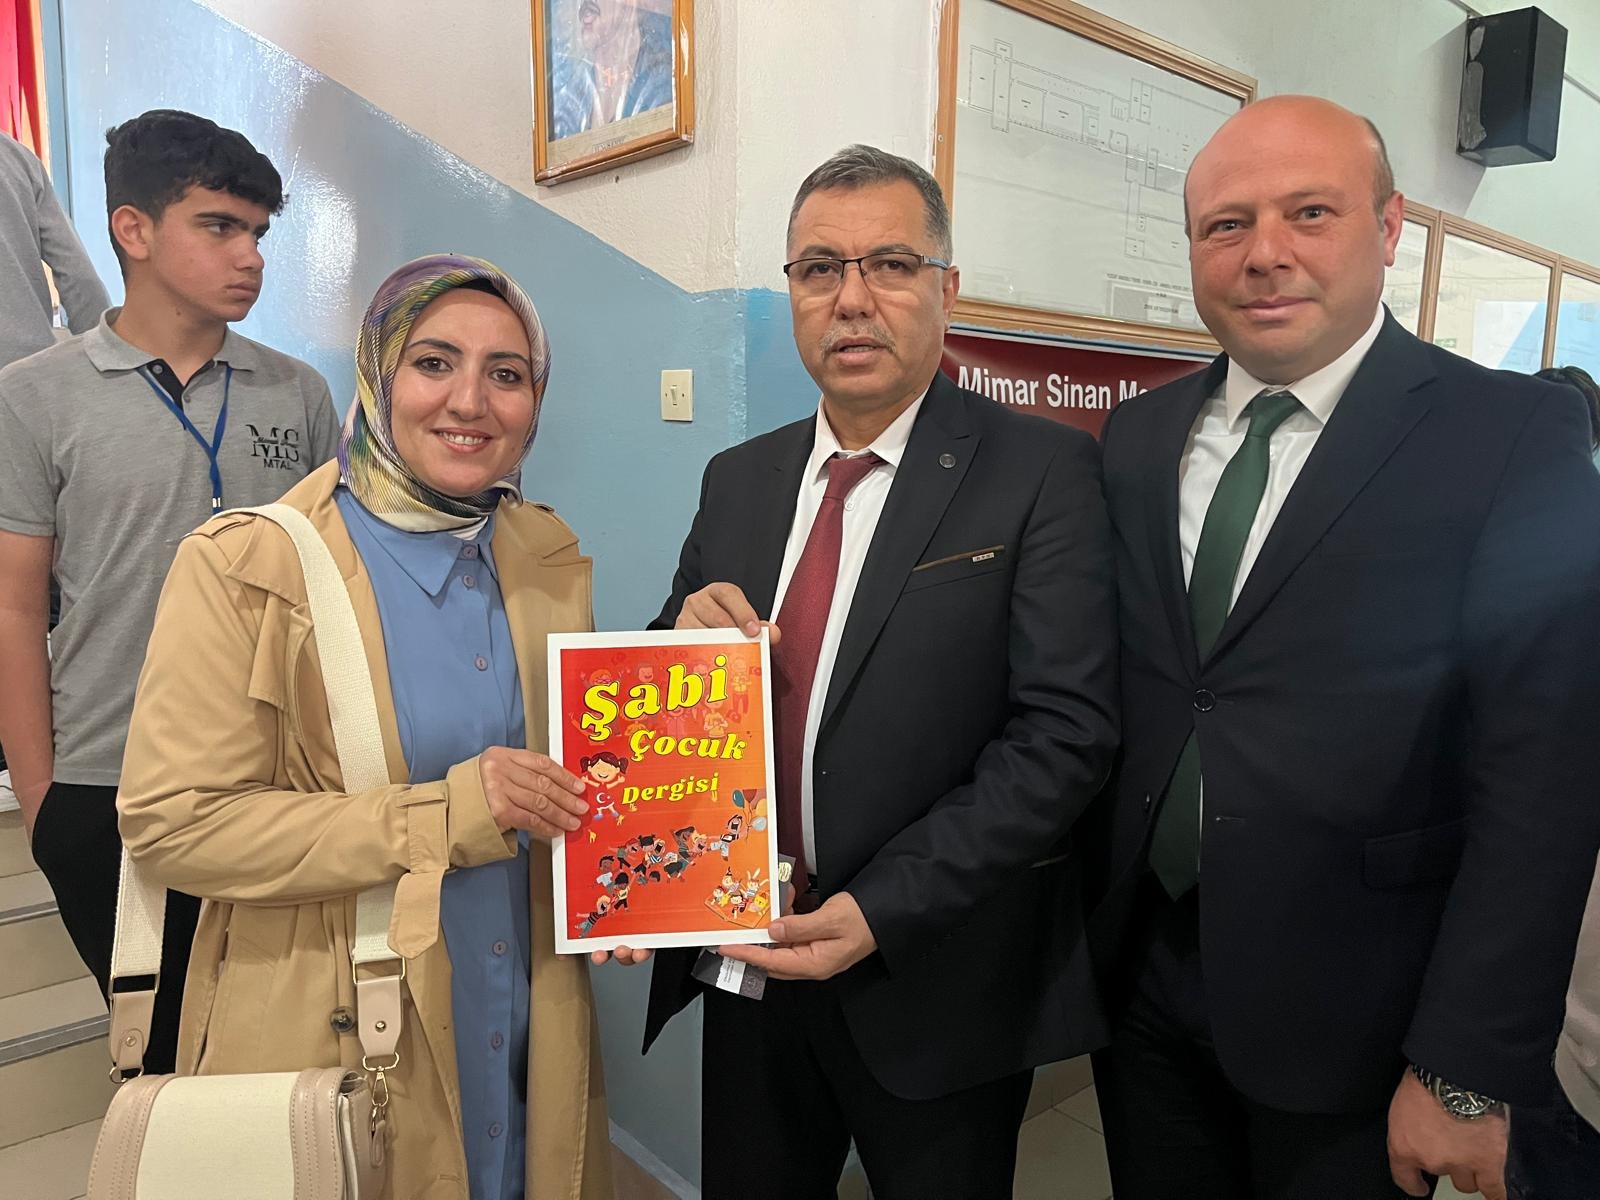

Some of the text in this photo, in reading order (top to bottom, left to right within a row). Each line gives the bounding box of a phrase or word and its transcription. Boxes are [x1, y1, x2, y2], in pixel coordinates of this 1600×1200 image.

[957, 366, 1039, 406] Mimar
[1046, 373, 1112, 410] Sinan
[580, 654, 729, 742] Şabi
[629, 729, 747, 762] Çocuk
[621, 773, 719, 804] Dergisi
